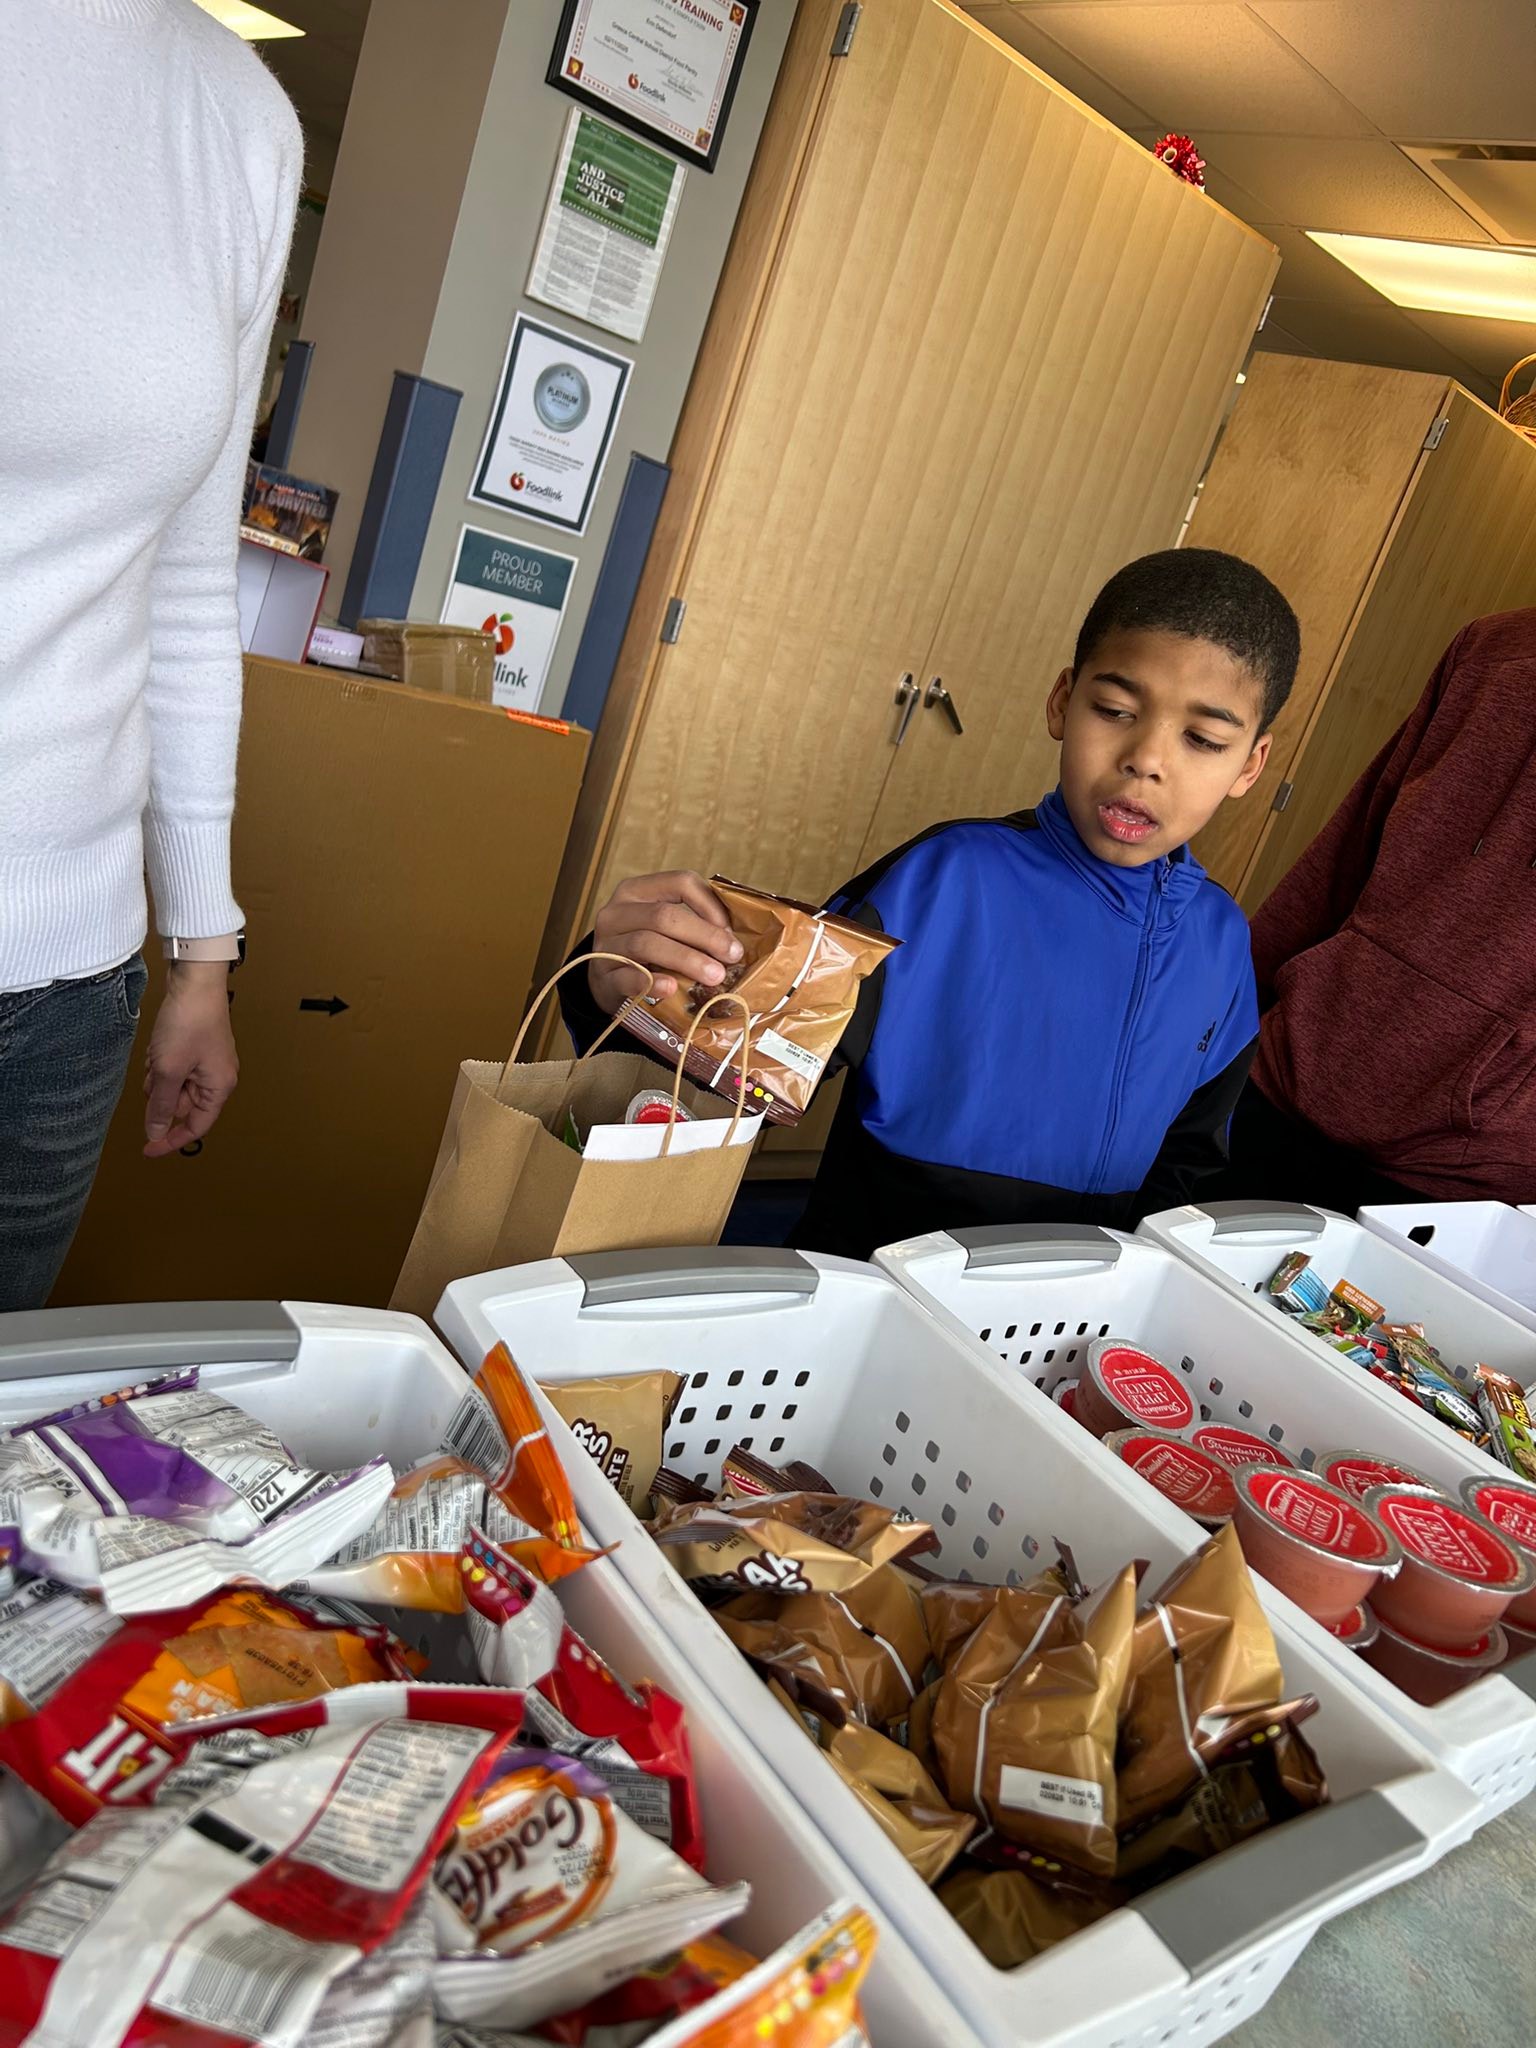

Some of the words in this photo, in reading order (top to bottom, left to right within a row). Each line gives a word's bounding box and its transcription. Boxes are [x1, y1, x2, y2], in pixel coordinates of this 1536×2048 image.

[679, 0, 724, 32] TRAINING
[639, 82, 666, 104] Foodlink
[580, 161, 606, 181] AND
[575, 183, 589, 195] FOR
[587, 190, 610, 209] ALL
[577, 173, 626, 203] JUSTICE
[526, 480, 564, 502] Foodlink
[491, 549, 542, 577] PROUD
[482, 564, 544, 595] MEMBER
[495, 661, 529, 688] link
[1120, 1380, 1163, 1395] SAUCE
[1127, 1391, 1170, 1405] APPLE
[1136, 1401, 1182, 1416] Strawberry
[1207, 1440, 1267, 1459] Strawberry
[1155, 1458, 1188, 1489] APPLE
[1169, 1469, 1204, 1497] SAUCE
[251, 1480, 287, 1513] 120
[453, 1507, 462, 1531] Sugars
[1289, 1496, 1315, 1531] APPLE
[1307, 1506, 1333, 1539] SAUCE
[409, 1515, 418, 1550] Cholesterol
[421, 1525, 431, 1550] Sodium
[432, 1532, 440, 1550] Total
[441, 1526, 450, 1546] Dietary
